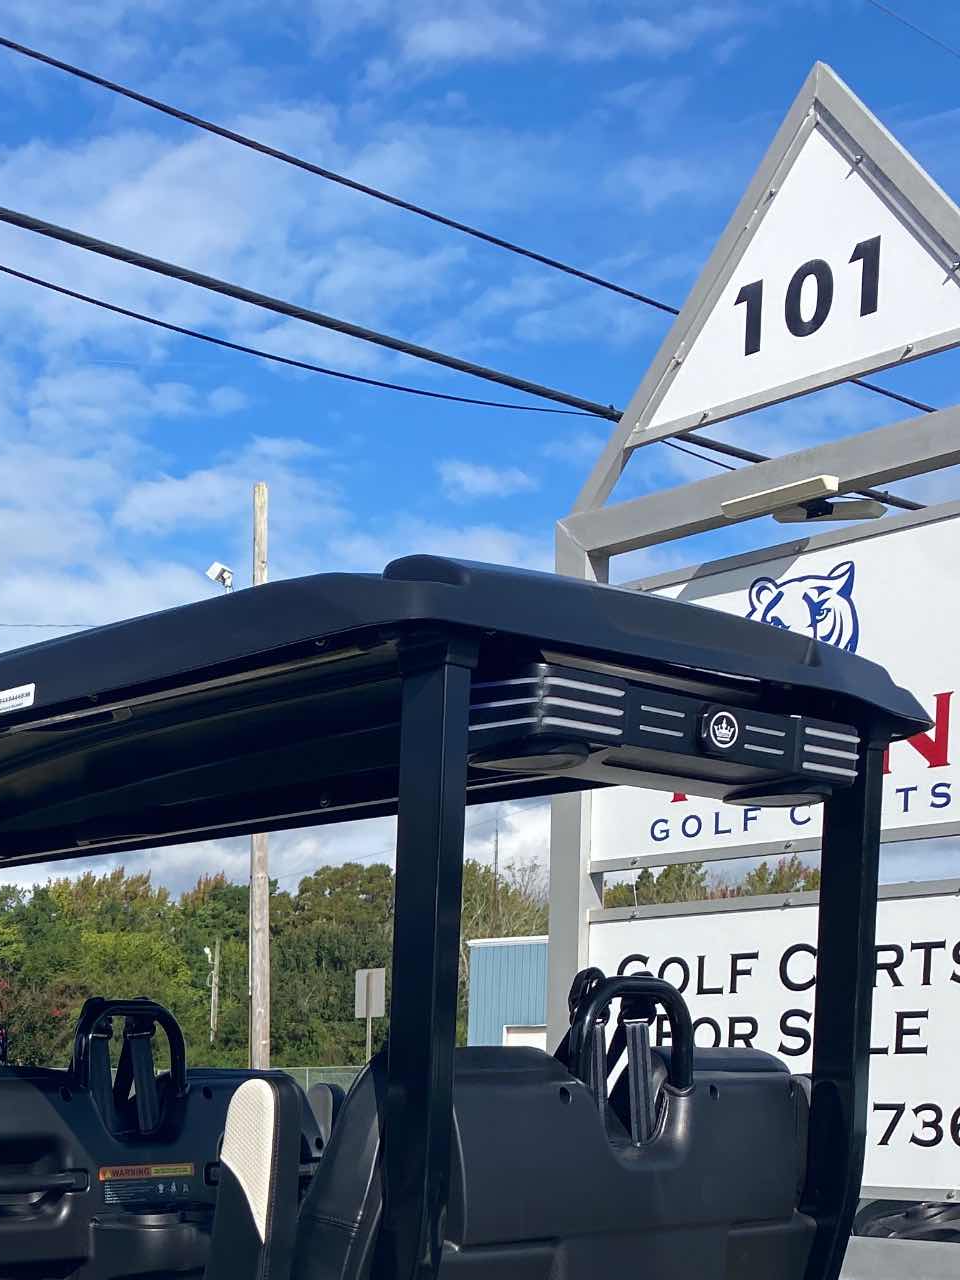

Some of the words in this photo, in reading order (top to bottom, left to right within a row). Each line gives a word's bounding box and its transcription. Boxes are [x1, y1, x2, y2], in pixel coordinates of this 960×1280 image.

[734, 235, 881, 356] 101
[650, 808, 761, 842] GOLF
[790, 782, 952, 826] CTS
[779, 938, 960, 992] CRT
[656, 1013, 758, 1048] FOR
[778, 1008, 929, 1056] SE
[112, 1168, 151, 1177] WARNING
